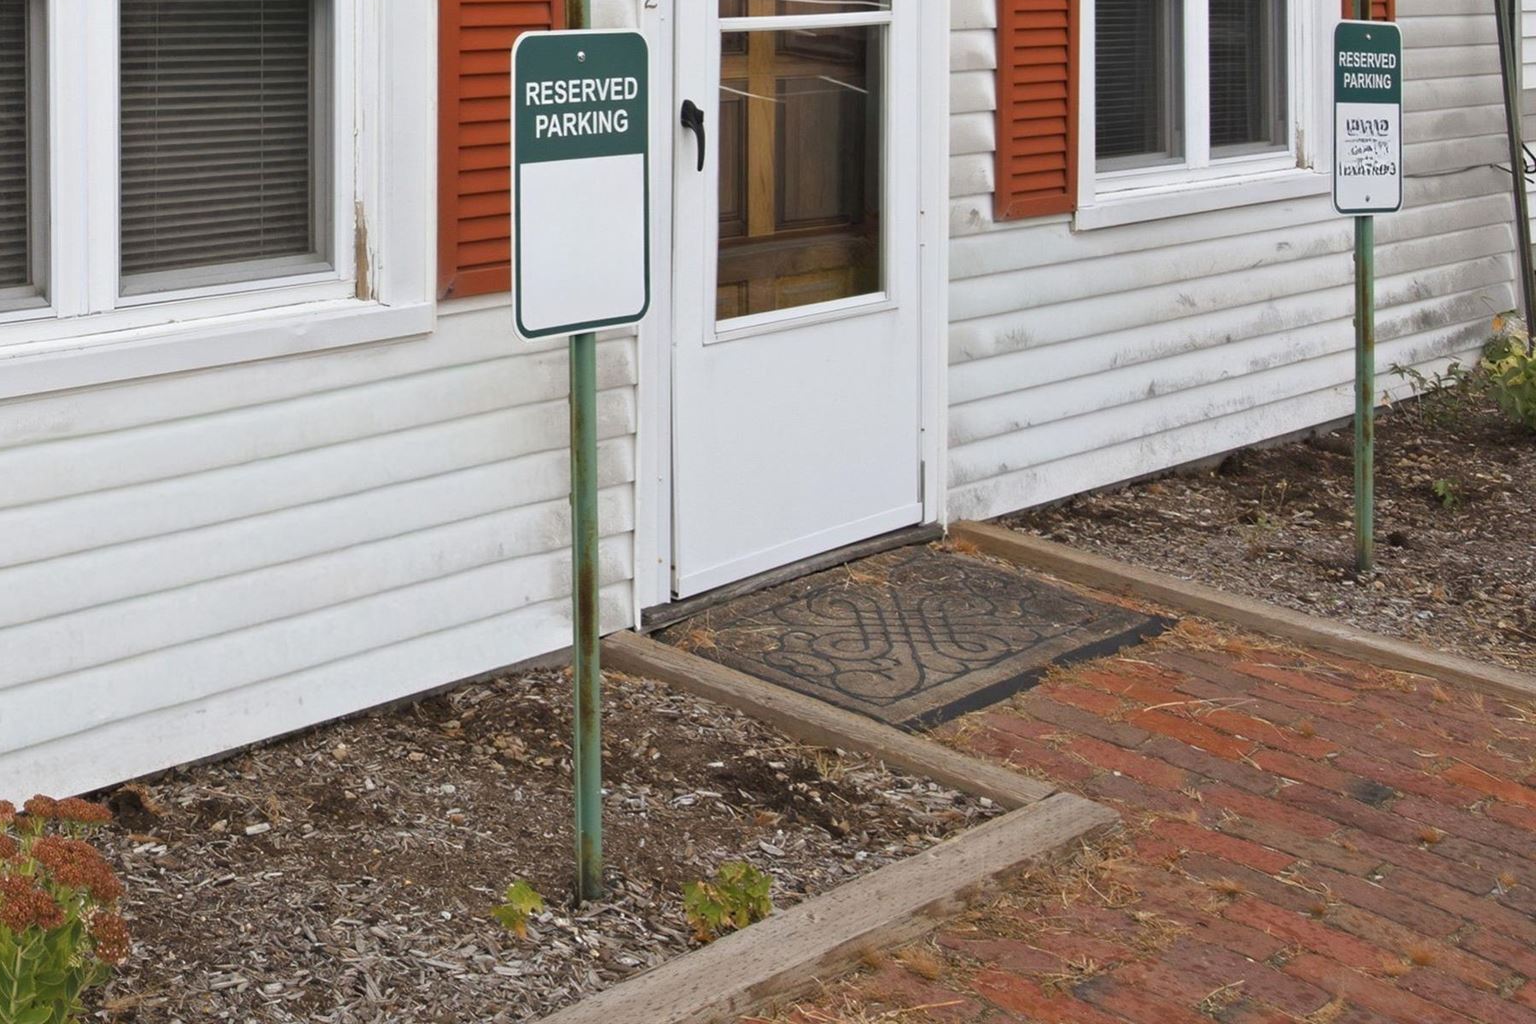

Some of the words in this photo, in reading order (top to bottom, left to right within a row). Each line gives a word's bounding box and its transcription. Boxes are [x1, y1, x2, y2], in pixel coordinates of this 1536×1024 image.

[1339, 51, 1397, 69] RESERVED
[525, 76, 638, 107] RESERVED
[1343, 72, 1392, 89] PARKING
[535, 109, 629, 139] PARKING
